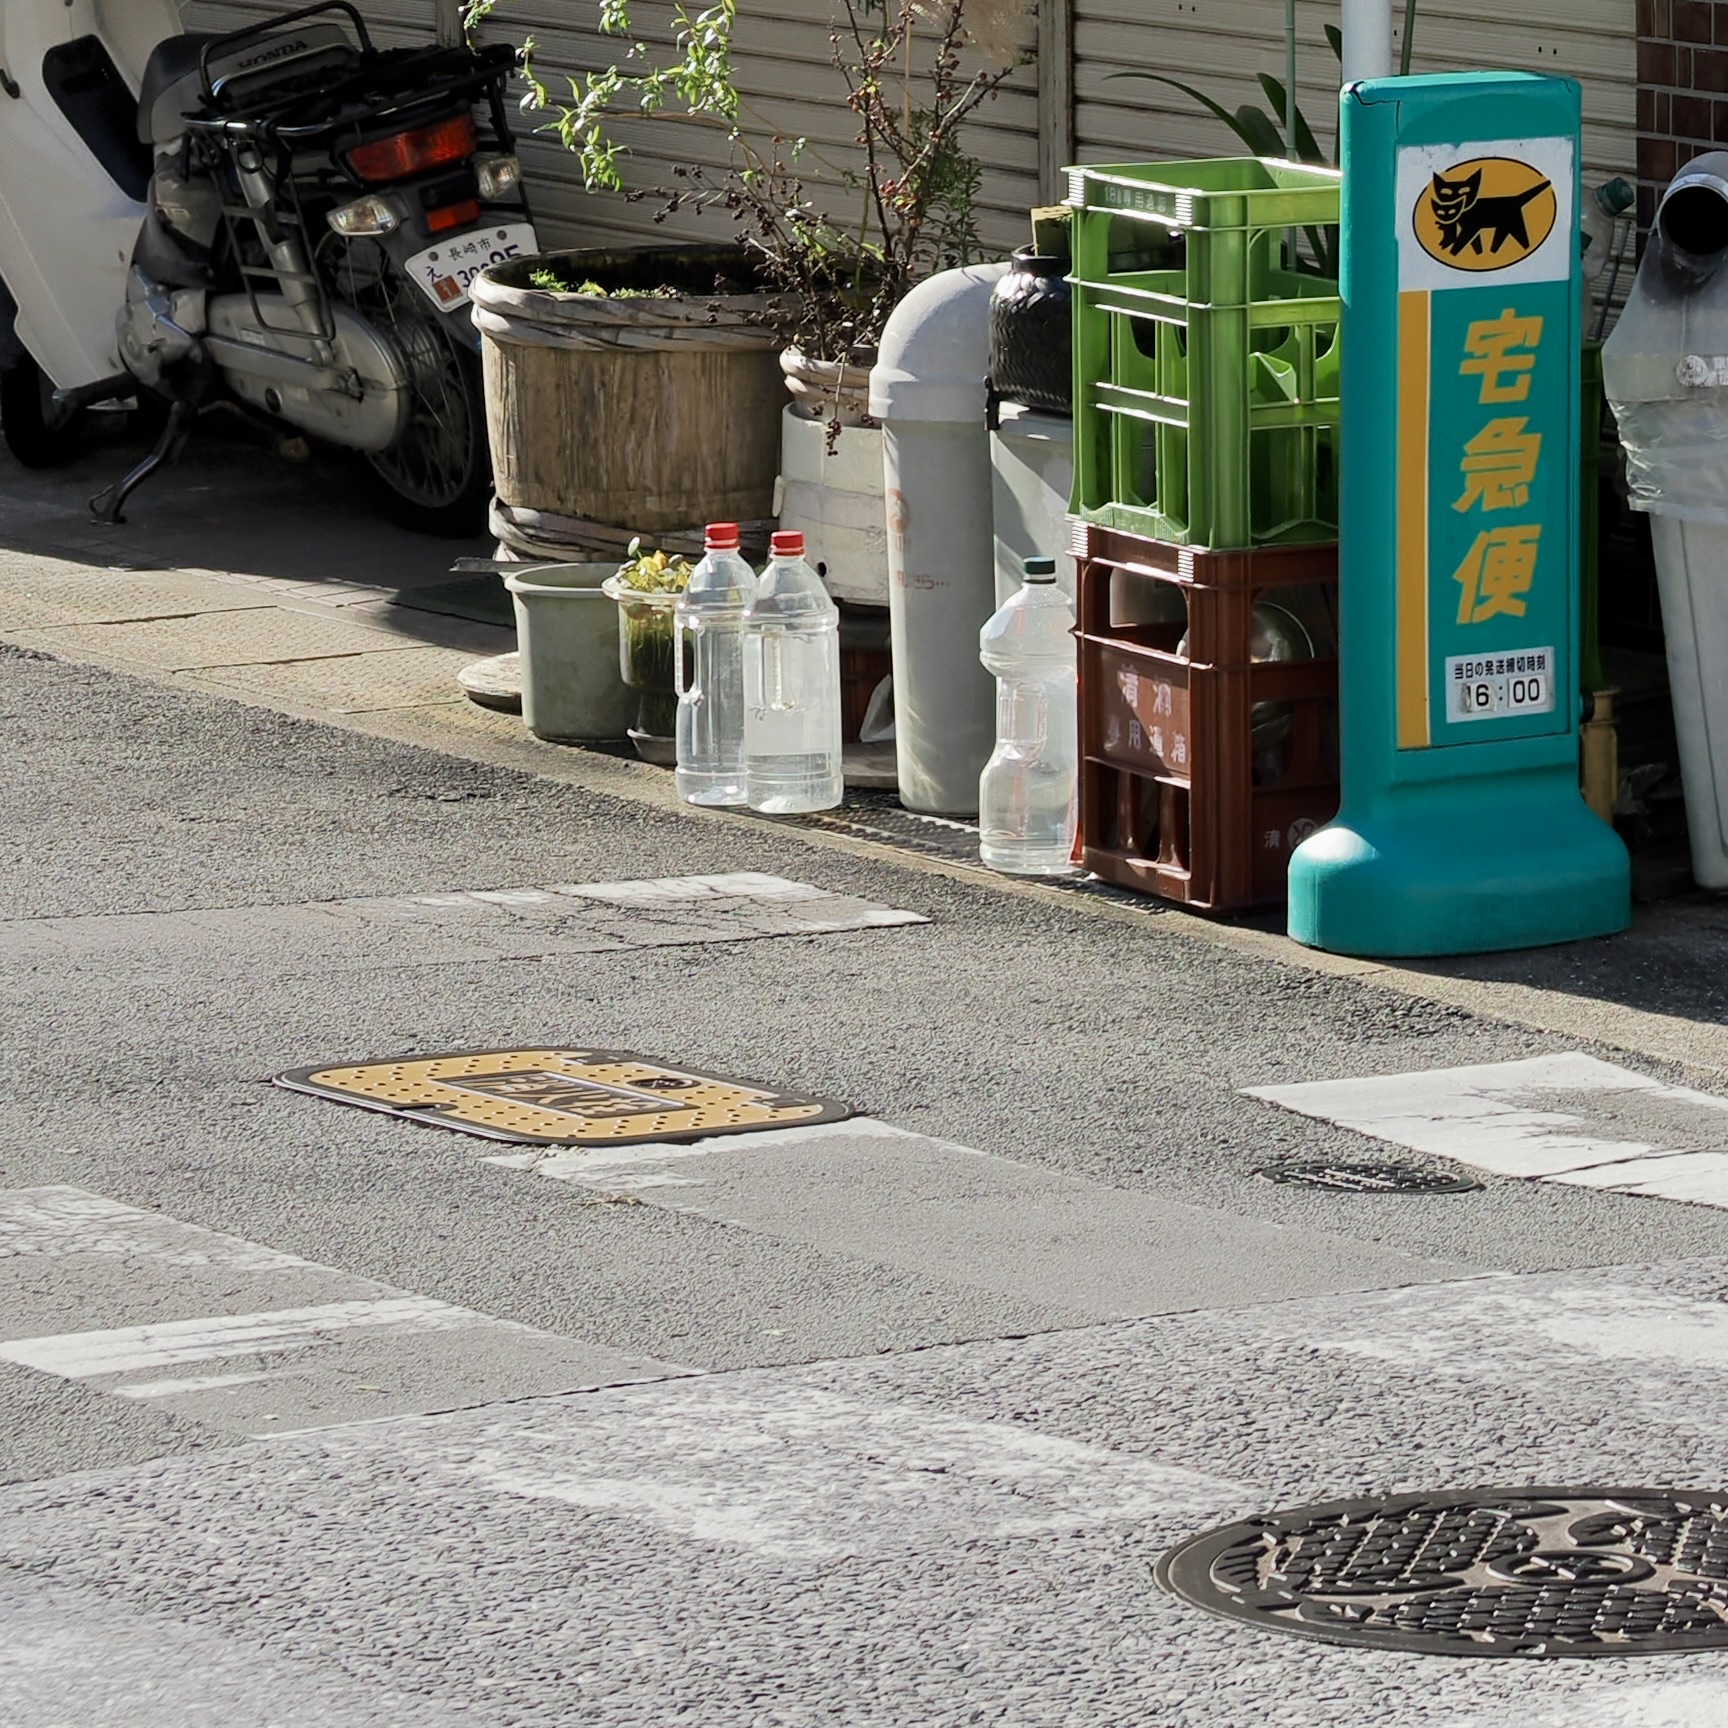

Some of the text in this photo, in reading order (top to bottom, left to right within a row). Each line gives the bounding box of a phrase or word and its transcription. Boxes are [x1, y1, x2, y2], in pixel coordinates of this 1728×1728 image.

[239, 40, 310, 68] HONDA
[449, 237, 492, 261] 長崎市
[424, 265, 444, 283] え
[1451, 307, 1544, 627] 宅急便
[1454, 654, 1546, 680] 当日の発送締切時刻
